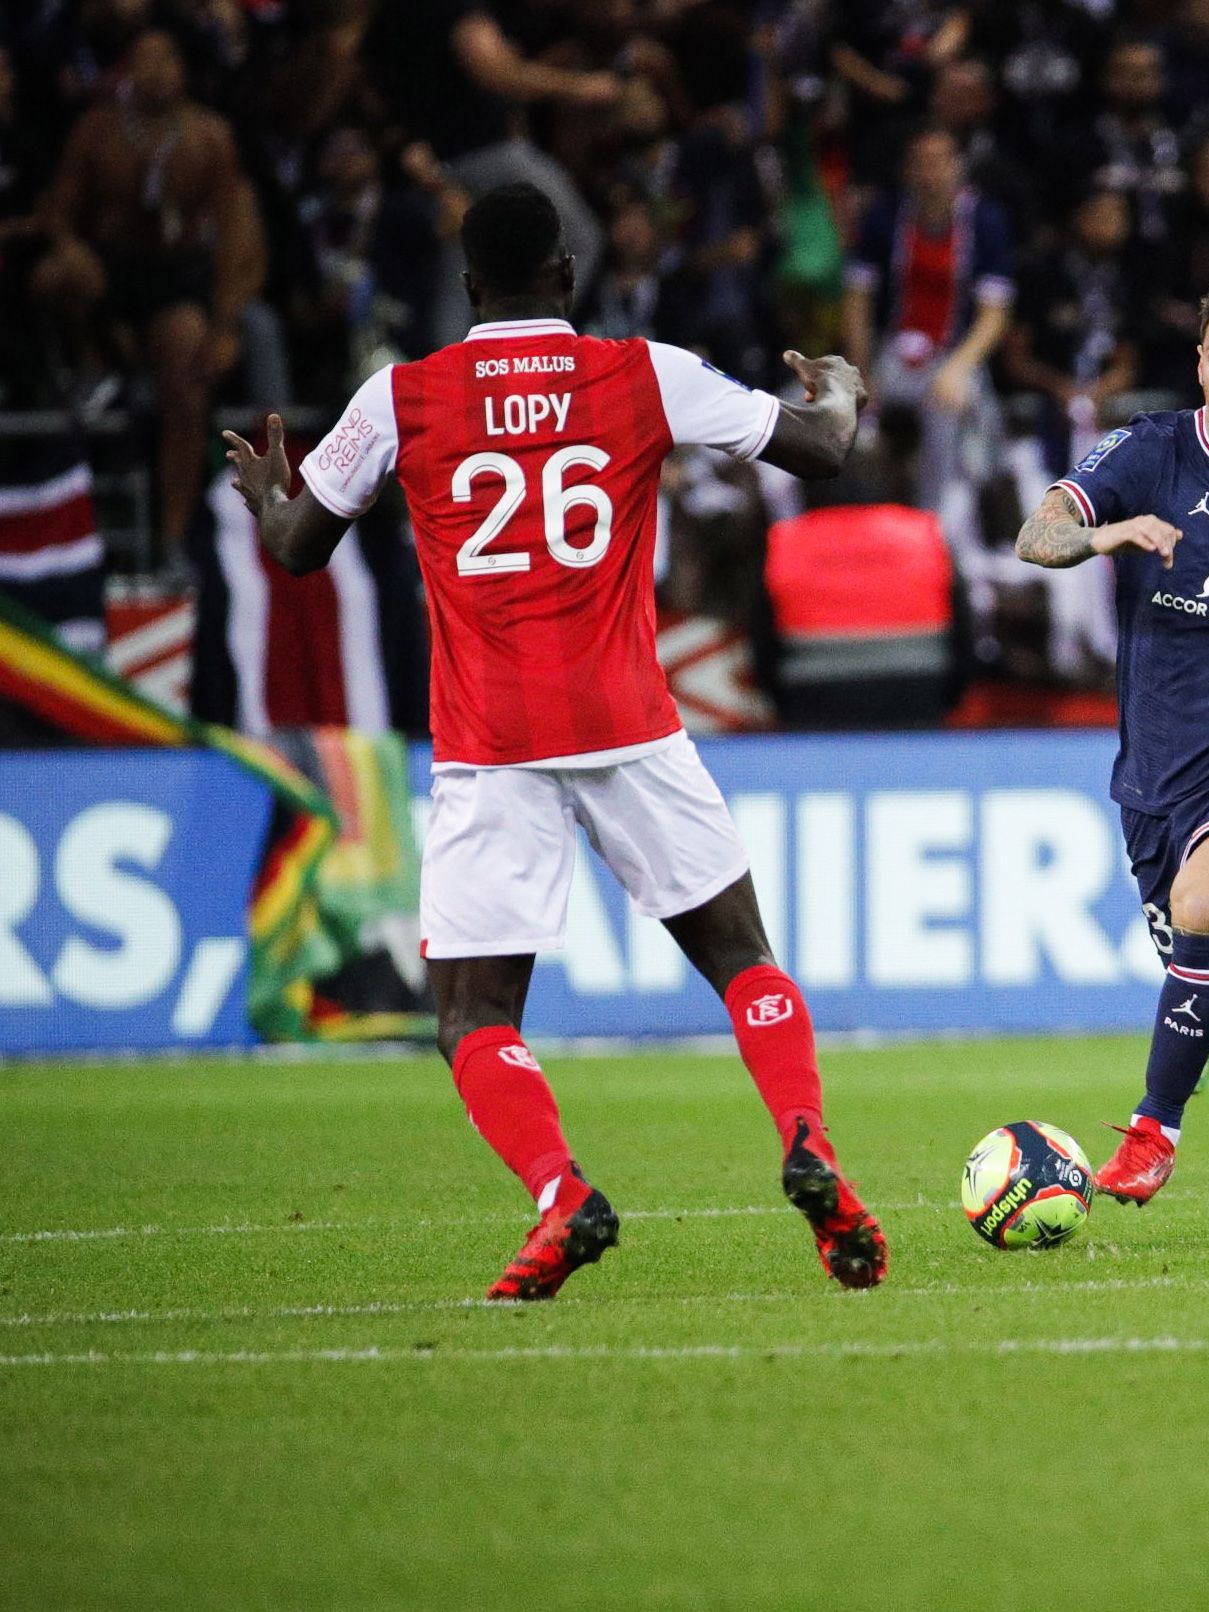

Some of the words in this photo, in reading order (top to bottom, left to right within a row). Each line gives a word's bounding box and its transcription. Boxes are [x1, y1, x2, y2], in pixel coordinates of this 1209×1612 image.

[475, 359, 510, 378] SOS
[513, 355, 576, 374] MALUS
[484, 392, 572, 436] LOPY
[318, 408, 362, 471] GRAND
[334, 419, 374, 474] REIMS
[451, 444, 613, 576] 26
[1151, 591, 1208, 617] ACCOR
[1163, 1016, 1204, 1038] PARIS
[980, 1177, 1033, 1237] uhlsport
